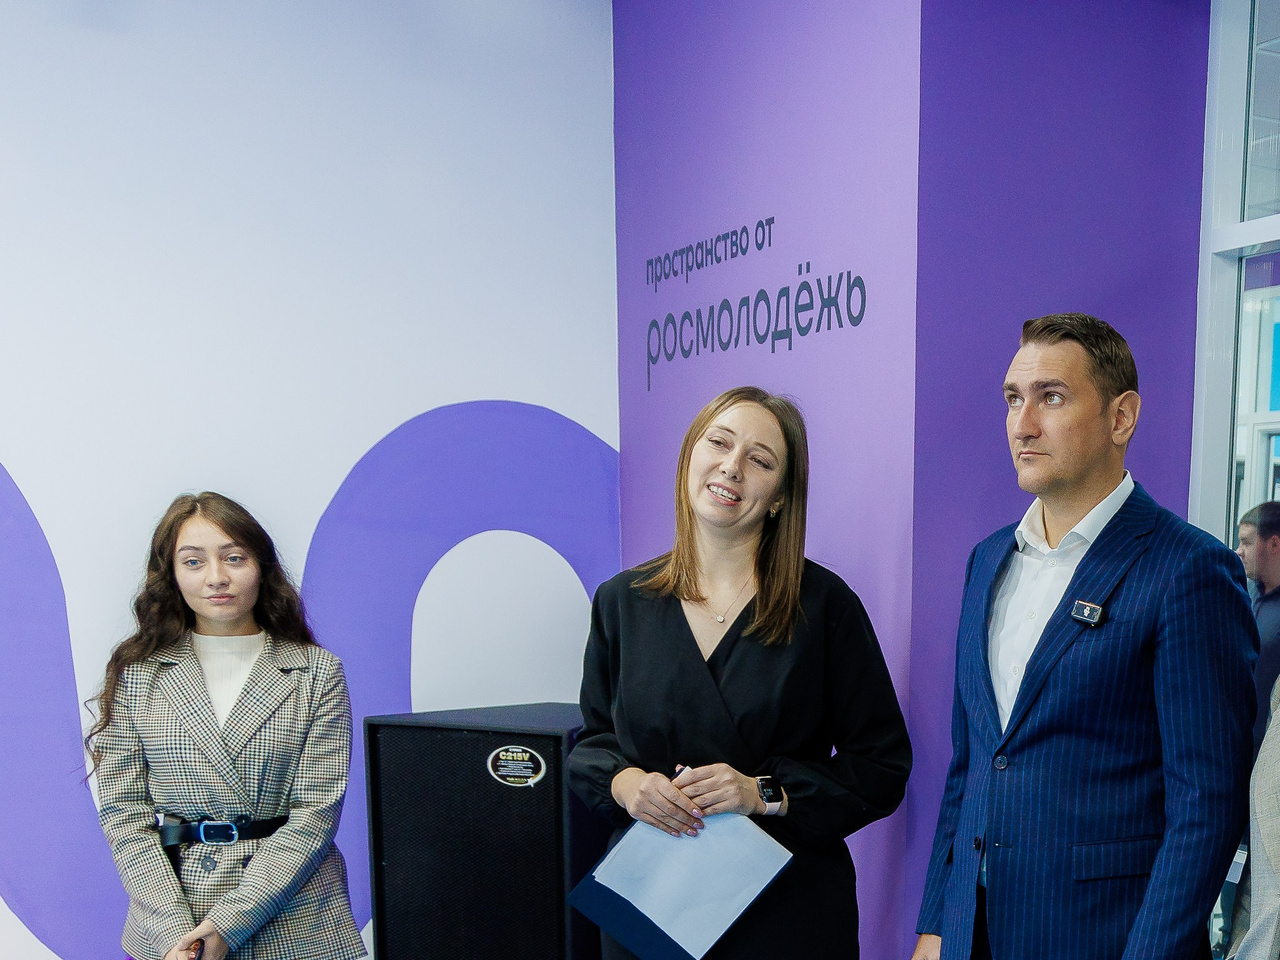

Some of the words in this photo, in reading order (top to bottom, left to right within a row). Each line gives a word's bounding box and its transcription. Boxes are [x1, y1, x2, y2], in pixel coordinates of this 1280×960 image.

[646, 225, 750, 293] пространство
[755, 216, 775, 251] от
[647, 261, 867, 391] росмолодёжь
[499, 752, 530, 761] C215V
